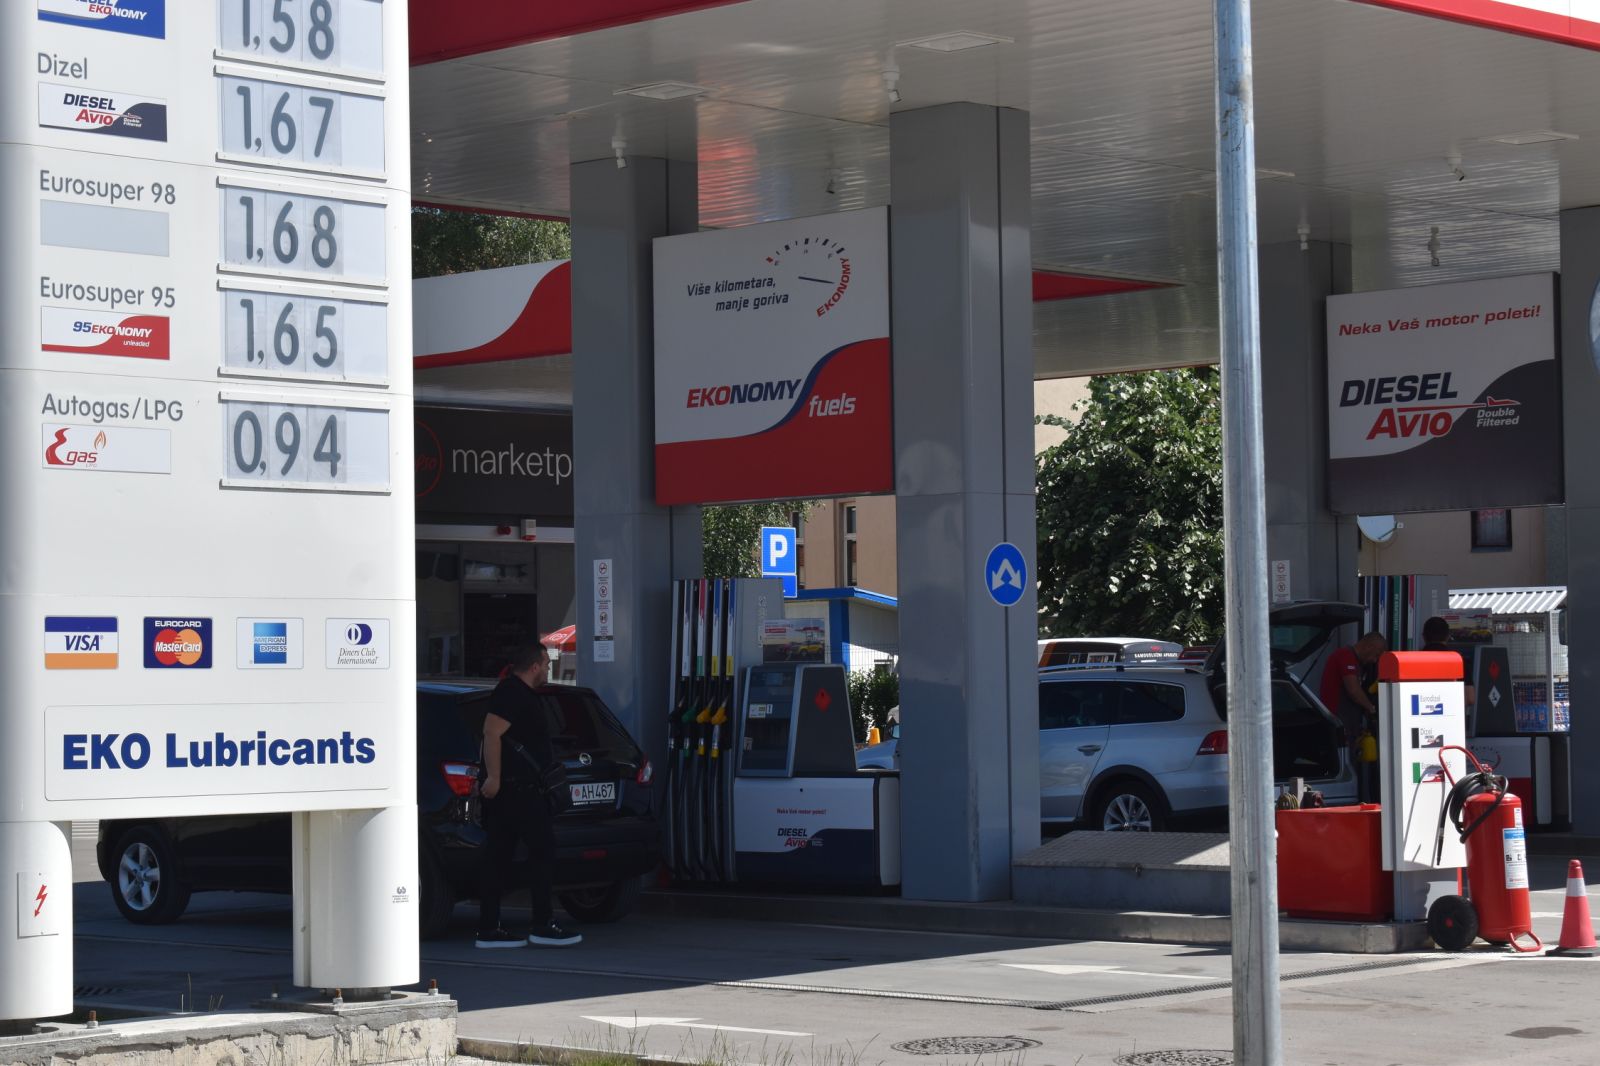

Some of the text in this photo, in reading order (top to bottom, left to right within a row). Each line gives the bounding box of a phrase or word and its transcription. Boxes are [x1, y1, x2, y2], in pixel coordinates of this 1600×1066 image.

[88, 3, 148, 21] EKONOMY
[242, 0, 335, 61] 1,58
[37, 52, 88, 80] Dizel
[63, 93, 117, 111] DIESEL
[236, 86, 335, 158] 1,67
[39, 170, 177, 206] Eurosuper 98
[239, 196, 338, 269] 1,68
[39, 276, 176, 310] Eurosuper 95
[687, 275, 777, 297] Više kilometara,
[816, 257, 852, 318] EKONOMY
[715, 292, 790, 313] manje goriva
[72, 321, 153, 339] 95EKONOMY
[1338, 304, 1542, 337] Neka Vaš motor poleti!
[123, 339, 151, 348] unleaded
[240, 298, 338, 368] 1,65
[686, 378, 857, 418] EKONOMY fuels
[1339, 371, 1459, 408] DIESEL
[42, 392, 184, 424] Autogas/LPG
[1476, 408, 1516, 418] Double
[1476, 416, 1520, 428] Filtered
[233, 409, 342, 478] 0,94
[769, 533, 788, 567] P
[154, 620, 202, 628] EUROCARD
[64, 634, 100, 652] VISA
[154, 639, 201, 654] MasterCard
[253, 636, 286, 645] AMERICAN
[259, 644, 288, 652] EXPRESS
[336, 656, 379, 666] International
[339, 647, 376, 658] Diners Club
[62, 730, 377, 770] EKO Lubricants
[777, 827, 808, 837] DIESEL
